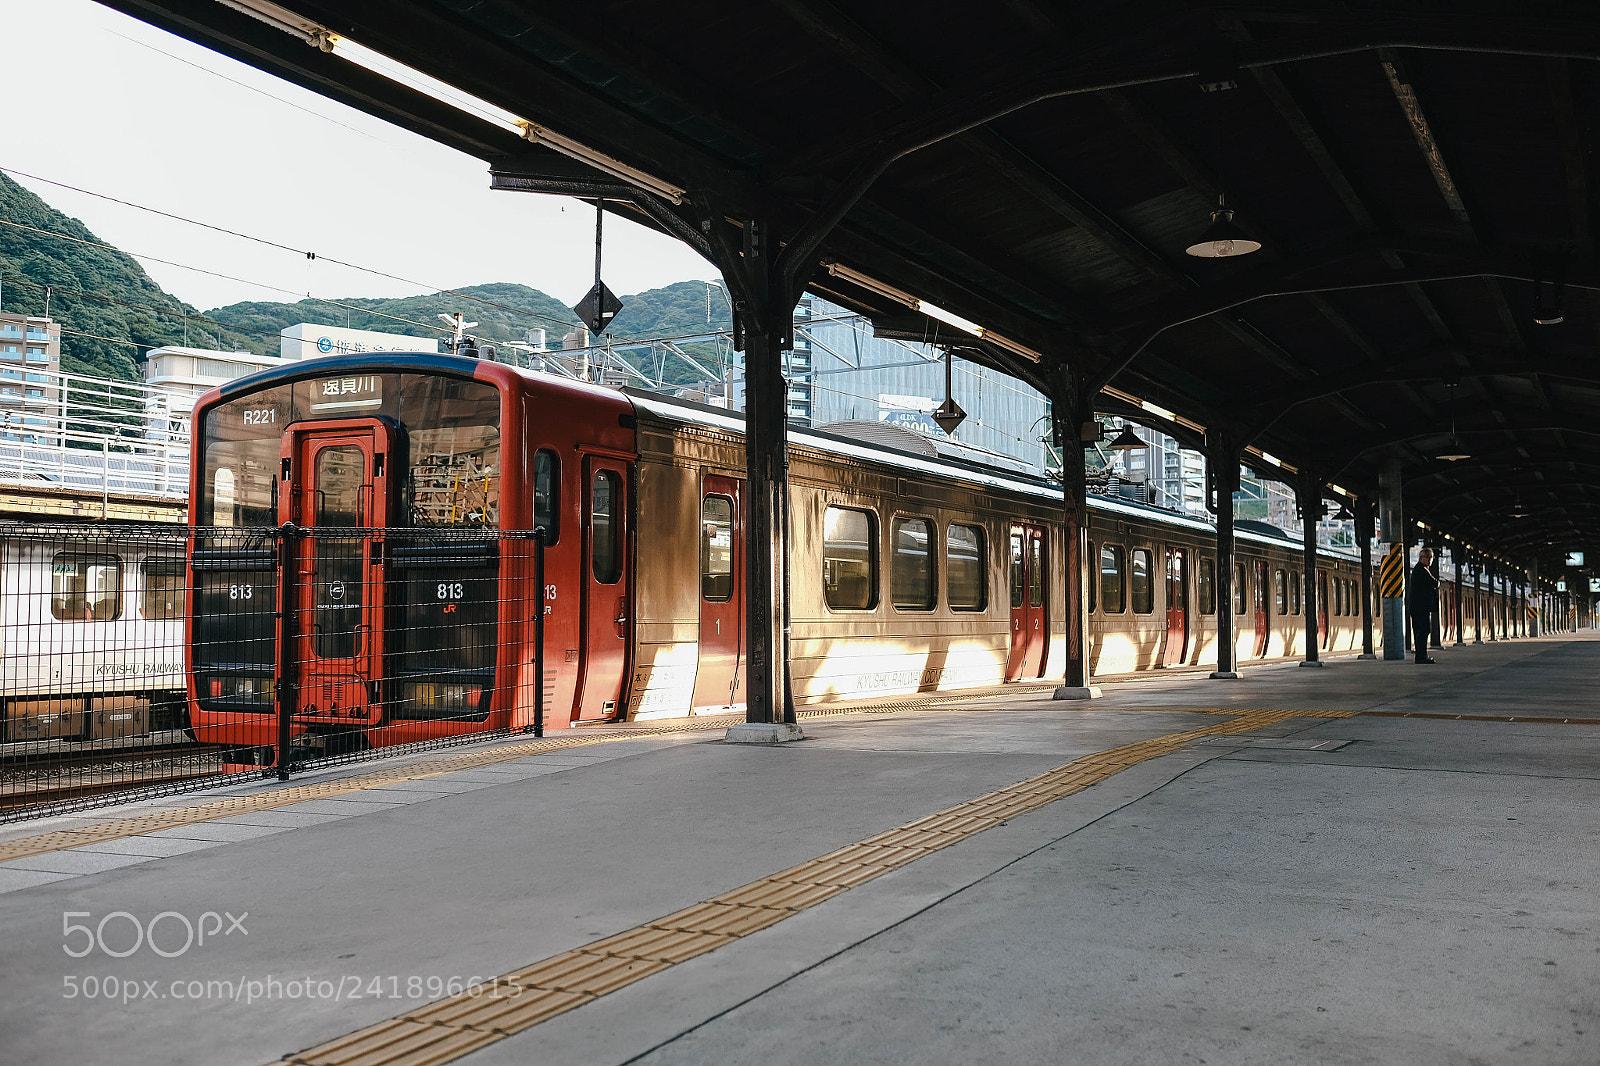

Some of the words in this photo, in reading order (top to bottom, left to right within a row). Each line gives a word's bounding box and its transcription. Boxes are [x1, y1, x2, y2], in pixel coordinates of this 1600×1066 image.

[243, 409, 275, 425] R221
[230, 585, 252, 599] 813
[437, 583, 463, 599] 813
[543, 585, 557, 600] 13
[443, 604, 457, 613] JR
[715, 618, 720, 635] 1
[1015, 618, 1019, 630] 2
[1034, 618, 1039, 630] 2
[96, 664, 140, 675] KYUSHU
[143, 663, 185, 674] RAILWAY
